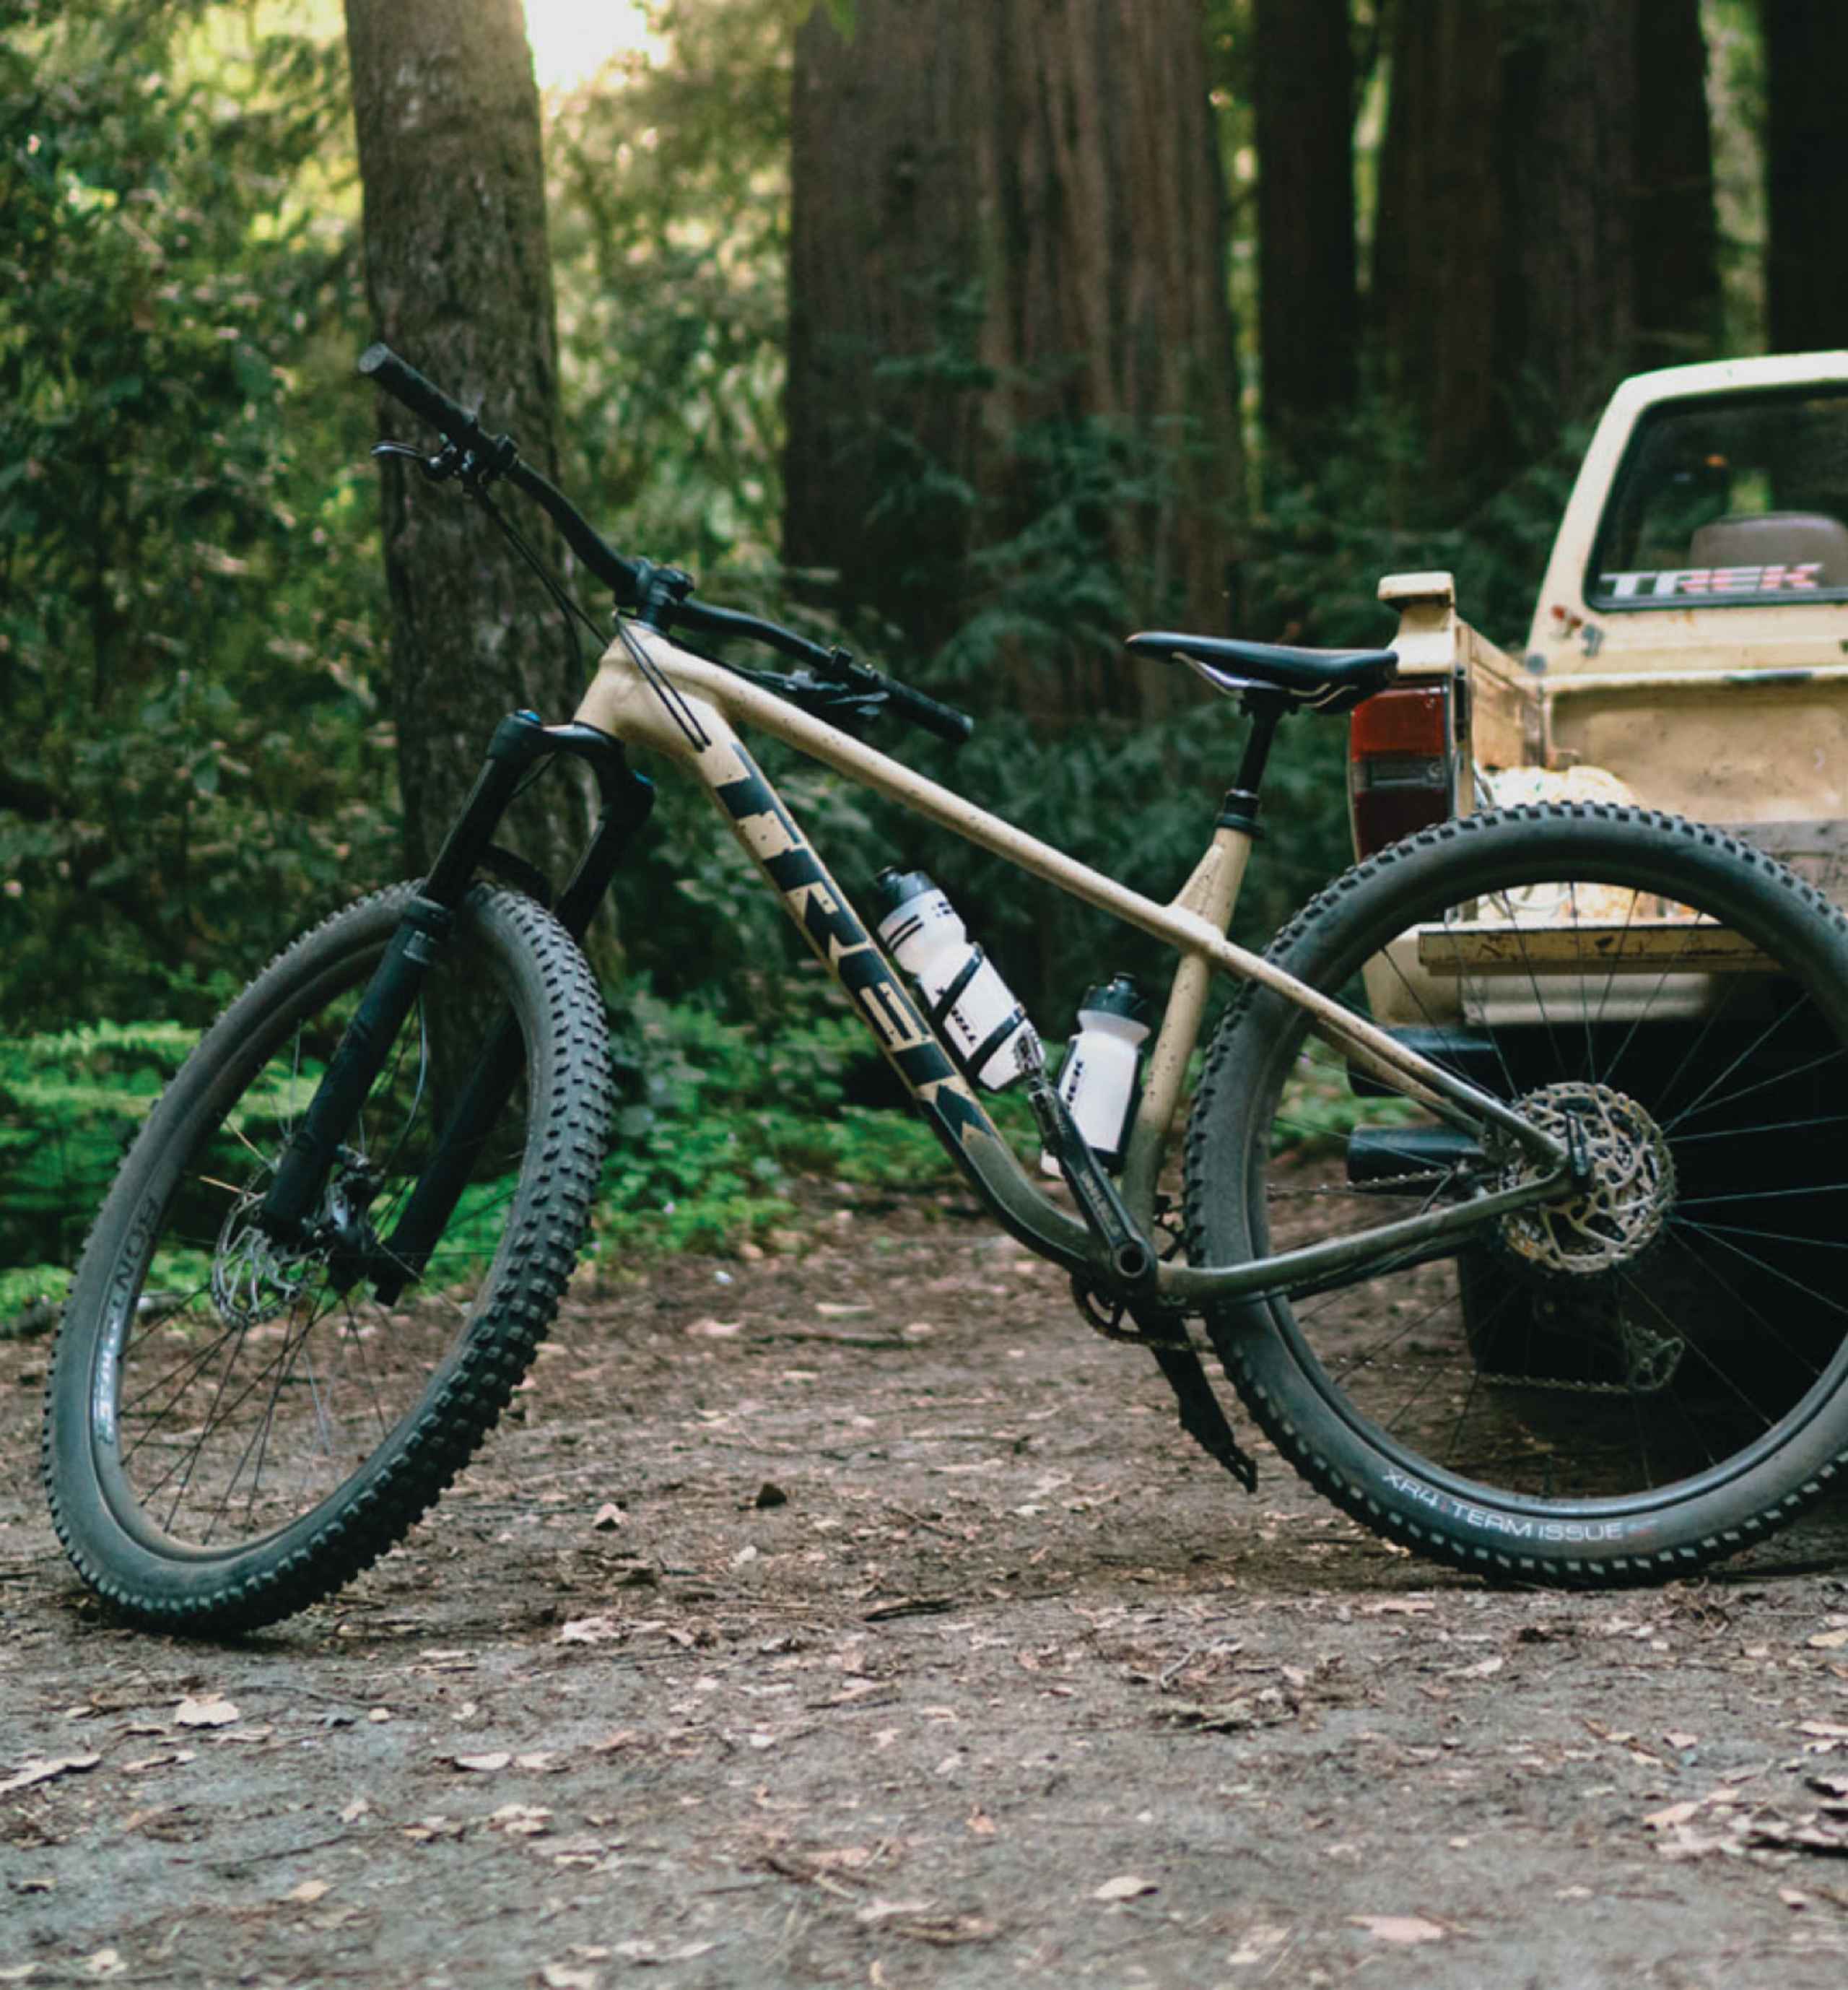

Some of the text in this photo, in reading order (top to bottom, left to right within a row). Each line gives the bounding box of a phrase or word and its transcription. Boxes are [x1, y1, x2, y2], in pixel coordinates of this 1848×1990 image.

[1599, 563, 1823, 598] TREK
[715, 742, 993, 1147] TREK
[1382, 1470, 1438, 1508] XR4
[1538, 1521, 1624, 1541] ISSUE
